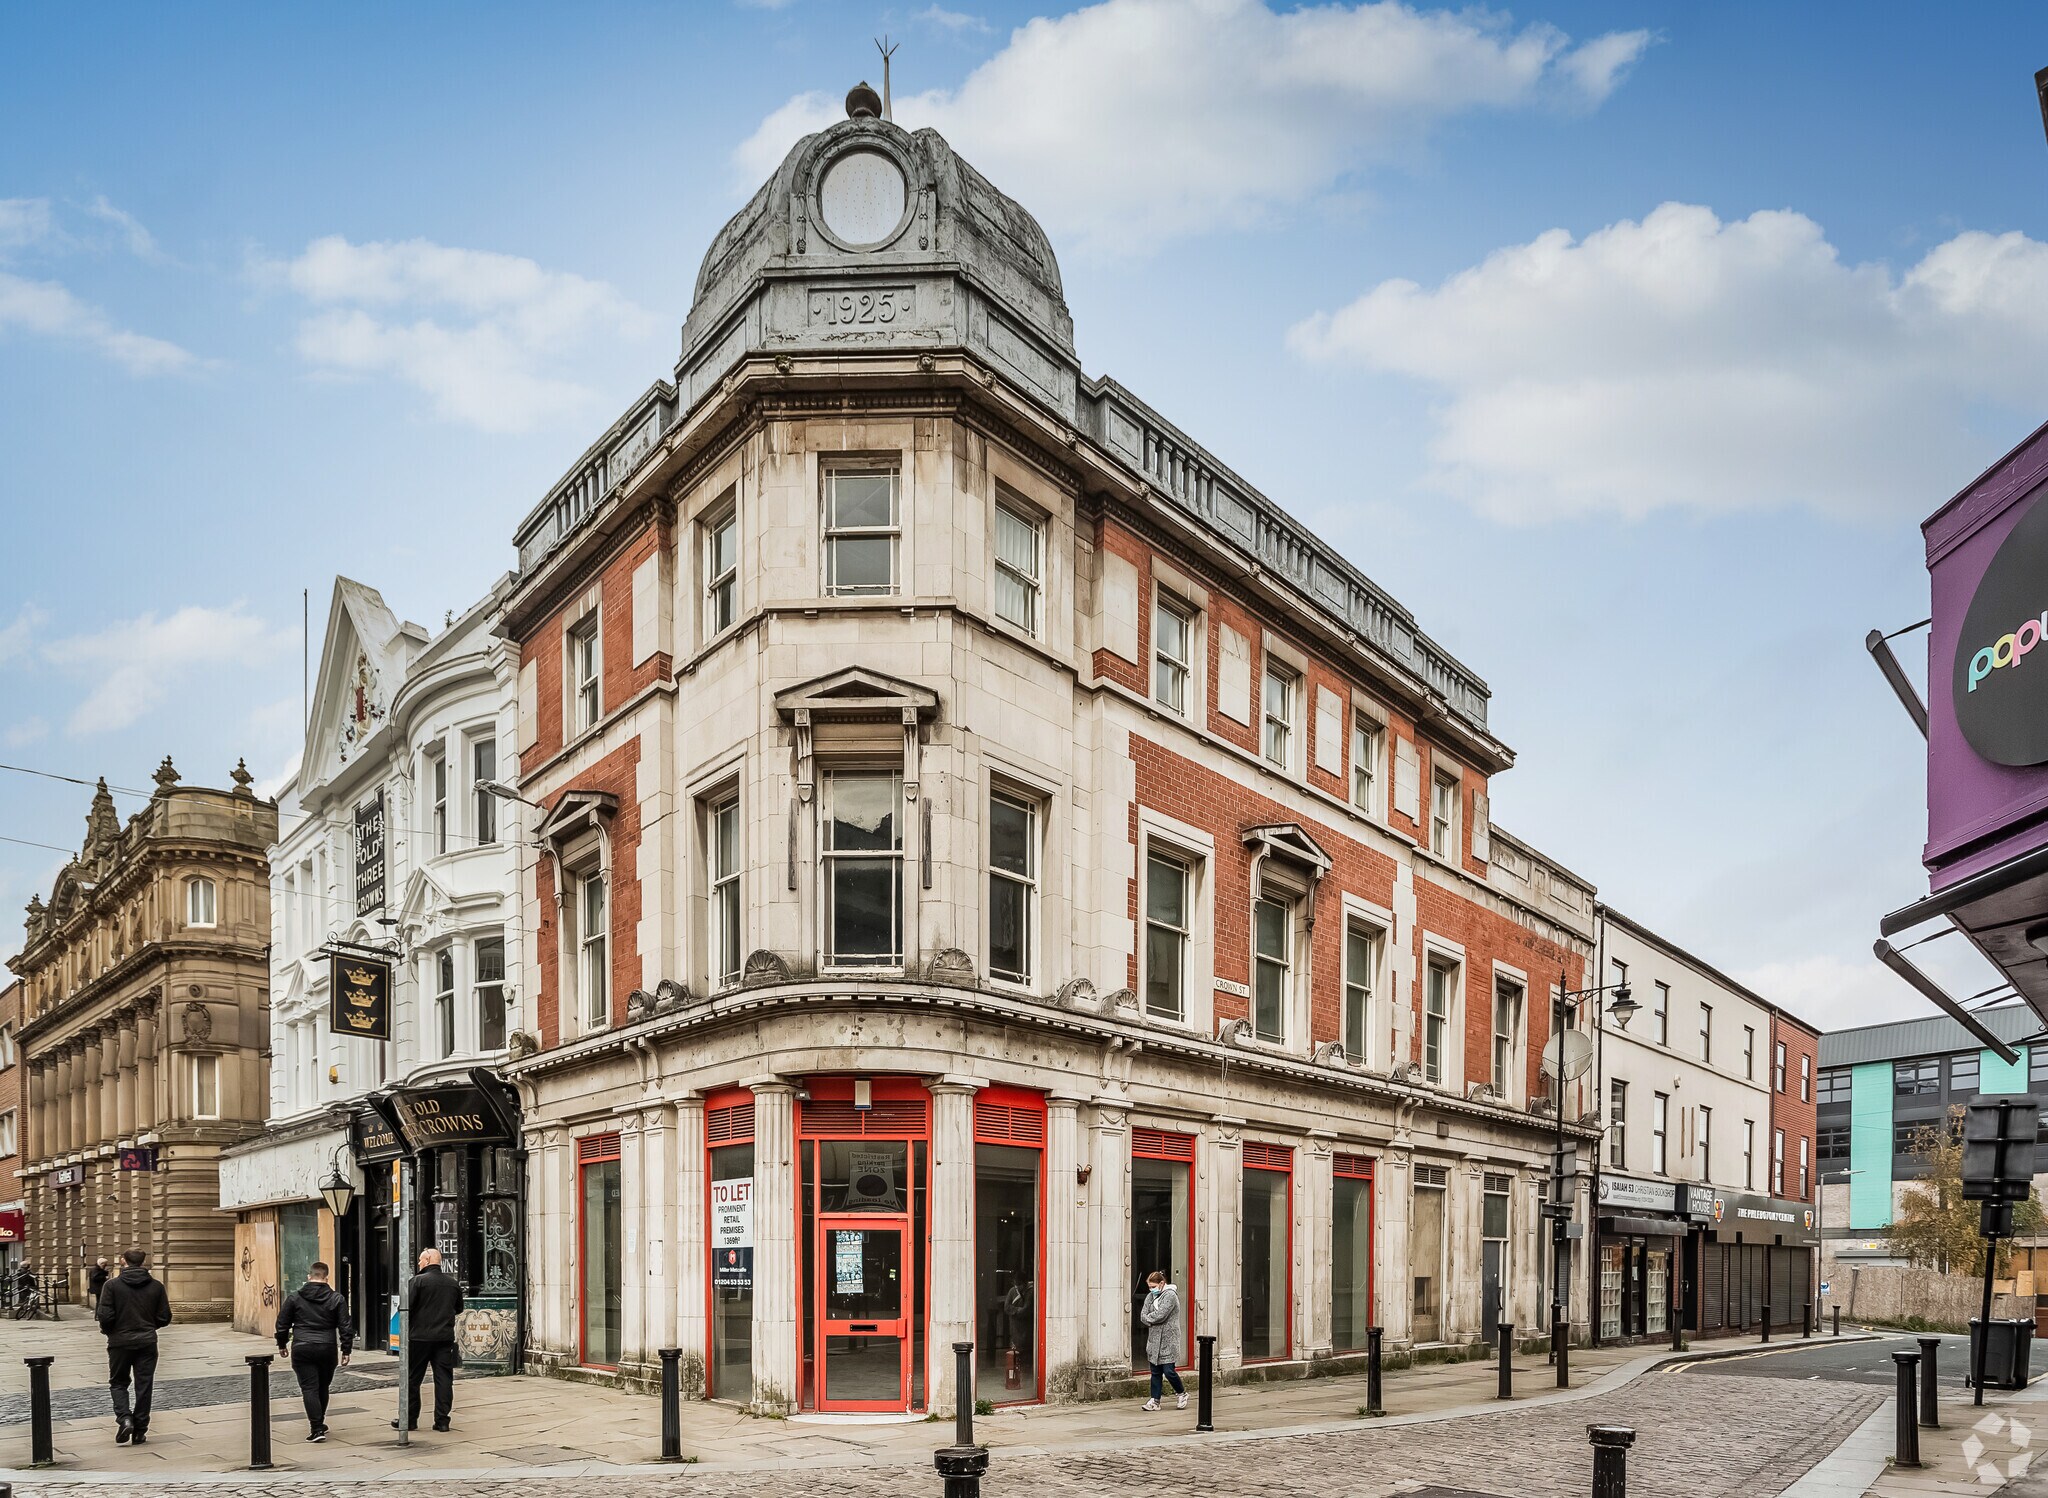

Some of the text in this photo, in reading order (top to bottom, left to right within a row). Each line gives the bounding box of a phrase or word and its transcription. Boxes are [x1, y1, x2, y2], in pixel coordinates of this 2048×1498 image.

[827, 293, 897, 325] 1925
[360, 815, 379, 841] THE
[360, 839, 379, 865] OLD
[357, 860, 383, 891] THREE
[357, 885, 383, 914] CROWNS
[1216, 979, 1246, 995] CROWN ST
[414, 1099, 440, 1116] OLD
[419, 1114, 484, 1136] CROWNS
[364, 1132, 395, 1148] WELCOME
[713, 1183, 751, 1203] TO LET
[1611, 1182, 1675, 1198] ISAIAH 53 CHRISTIAN BOOKSHOP
[1690, 1187, 1713, 1202] VANTAGE
[718, 1204, 746, 1213] PROMINENT
[1692, 1200, 1710, 1213] HOUSE
[724, 1215, 740, 1224] RETAIL
[720, 1226, 745, 1234] PREMISES
[438, 1239, 458, 1253] REE
[440, 1258, 459, 1273] WNS
